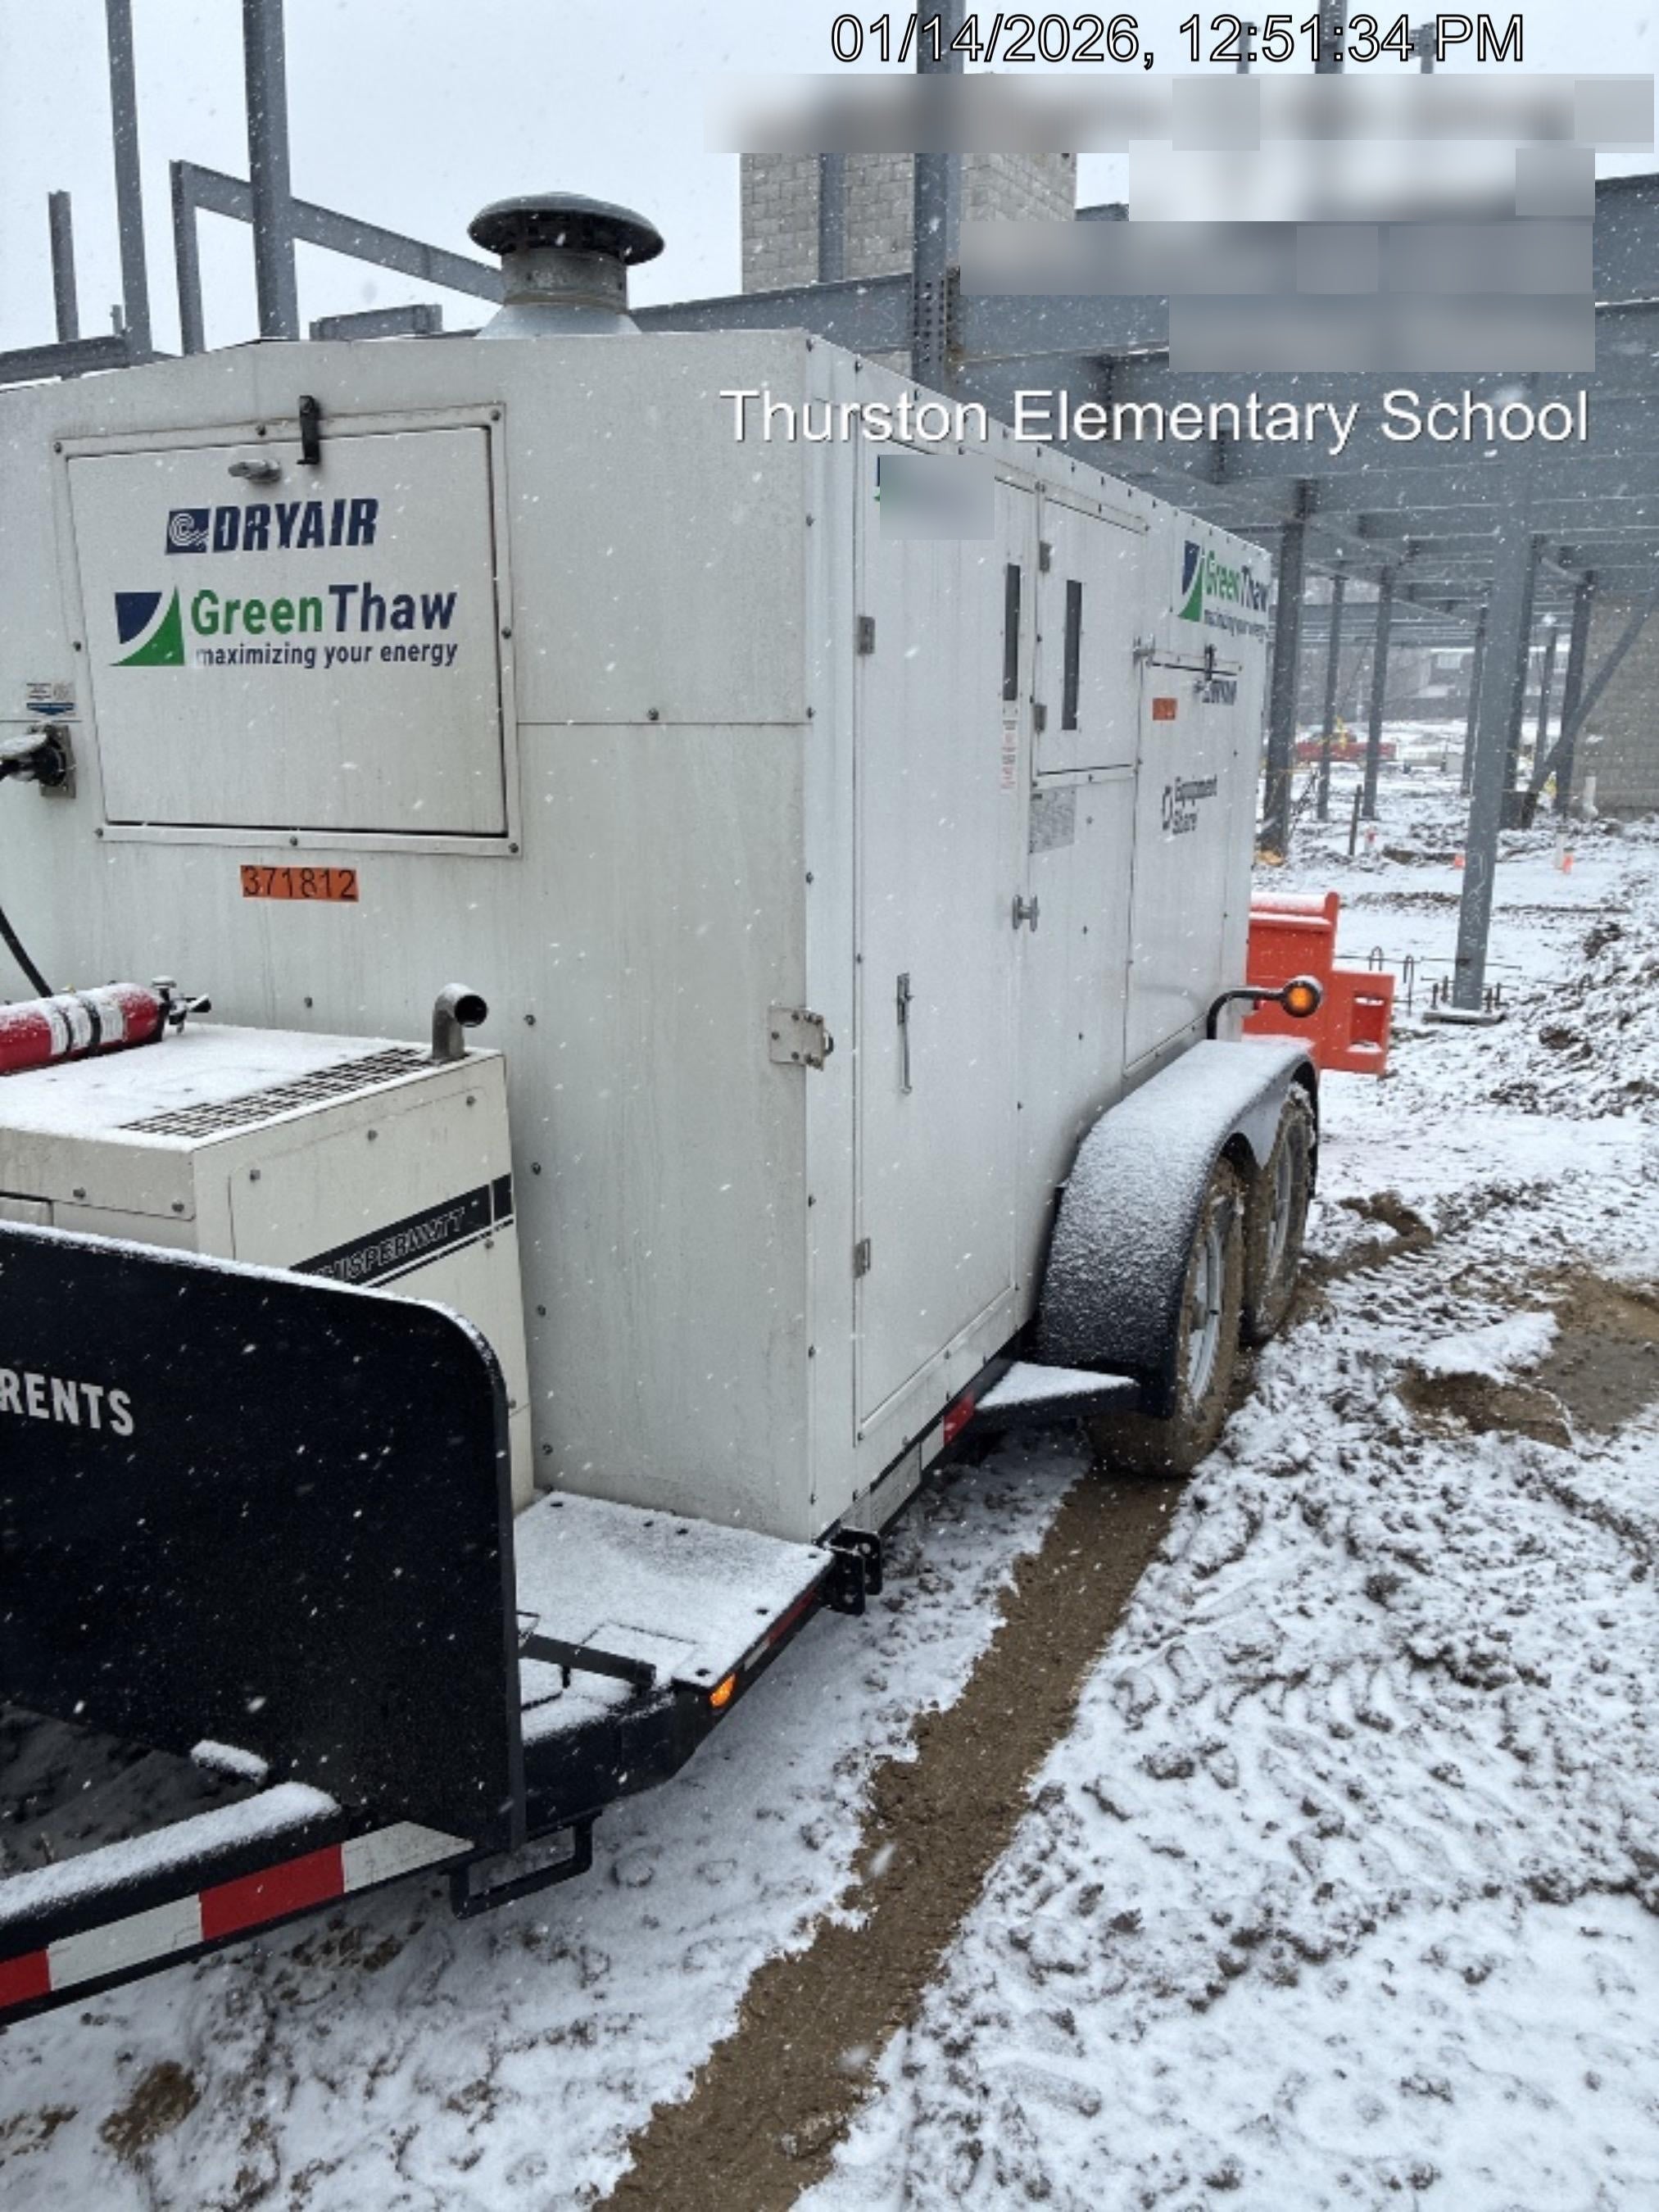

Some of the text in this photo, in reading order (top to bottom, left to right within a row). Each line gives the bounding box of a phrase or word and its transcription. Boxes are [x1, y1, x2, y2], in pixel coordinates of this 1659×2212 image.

[212, 497, 379, 554] DRYAIR
[196, 641, 458, 669] maximizing your energy
[243, 865, 356, 900] 371812
[0, 1367, 135, 1436] RENTS
